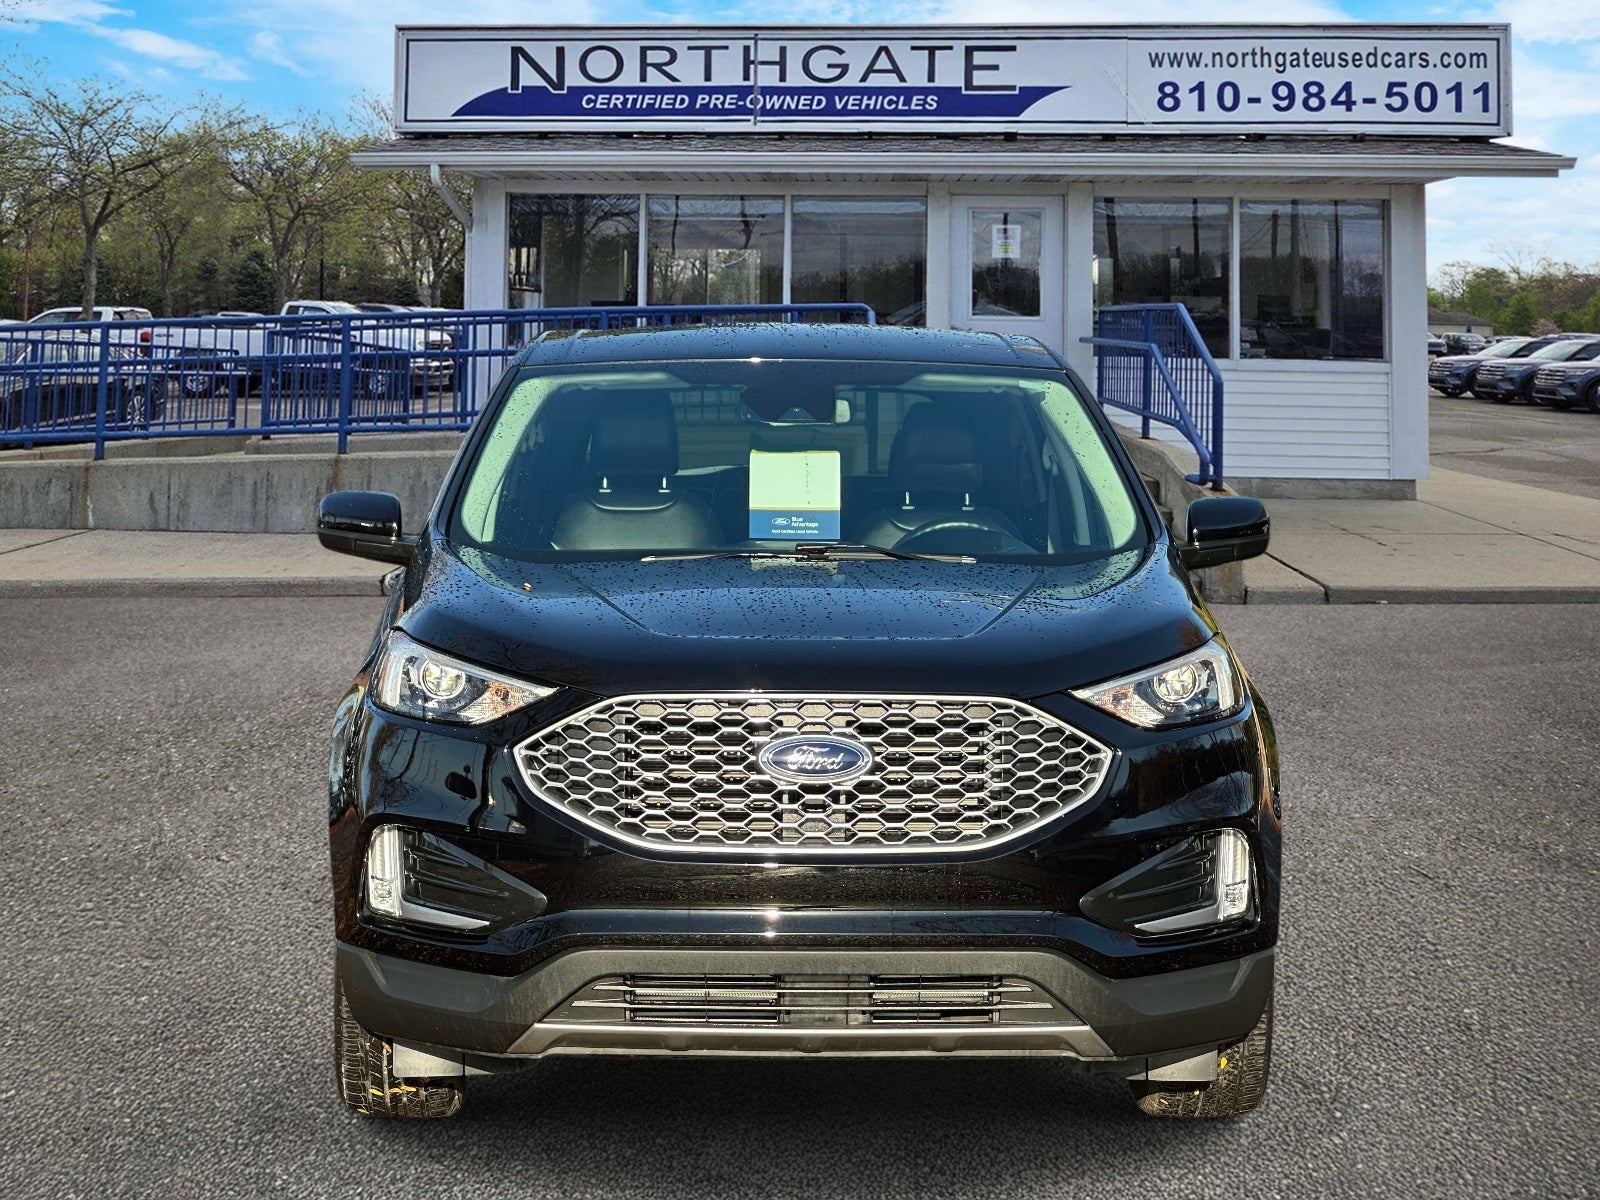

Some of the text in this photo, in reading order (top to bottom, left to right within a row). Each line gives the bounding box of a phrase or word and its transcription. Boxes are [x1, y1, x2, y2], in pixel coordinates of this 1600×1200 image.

[509, 45, 1018, 94] NORTHGATE
[1148, 46, 1488, 73] www.northgateusedcars.com
[581, 94, 939, 110] CERTIFIED PRE-OWNED VEHICLES
[1156, 80, 1490, 114] 810-984-5011
[787, 745, 844, 769] Ford
